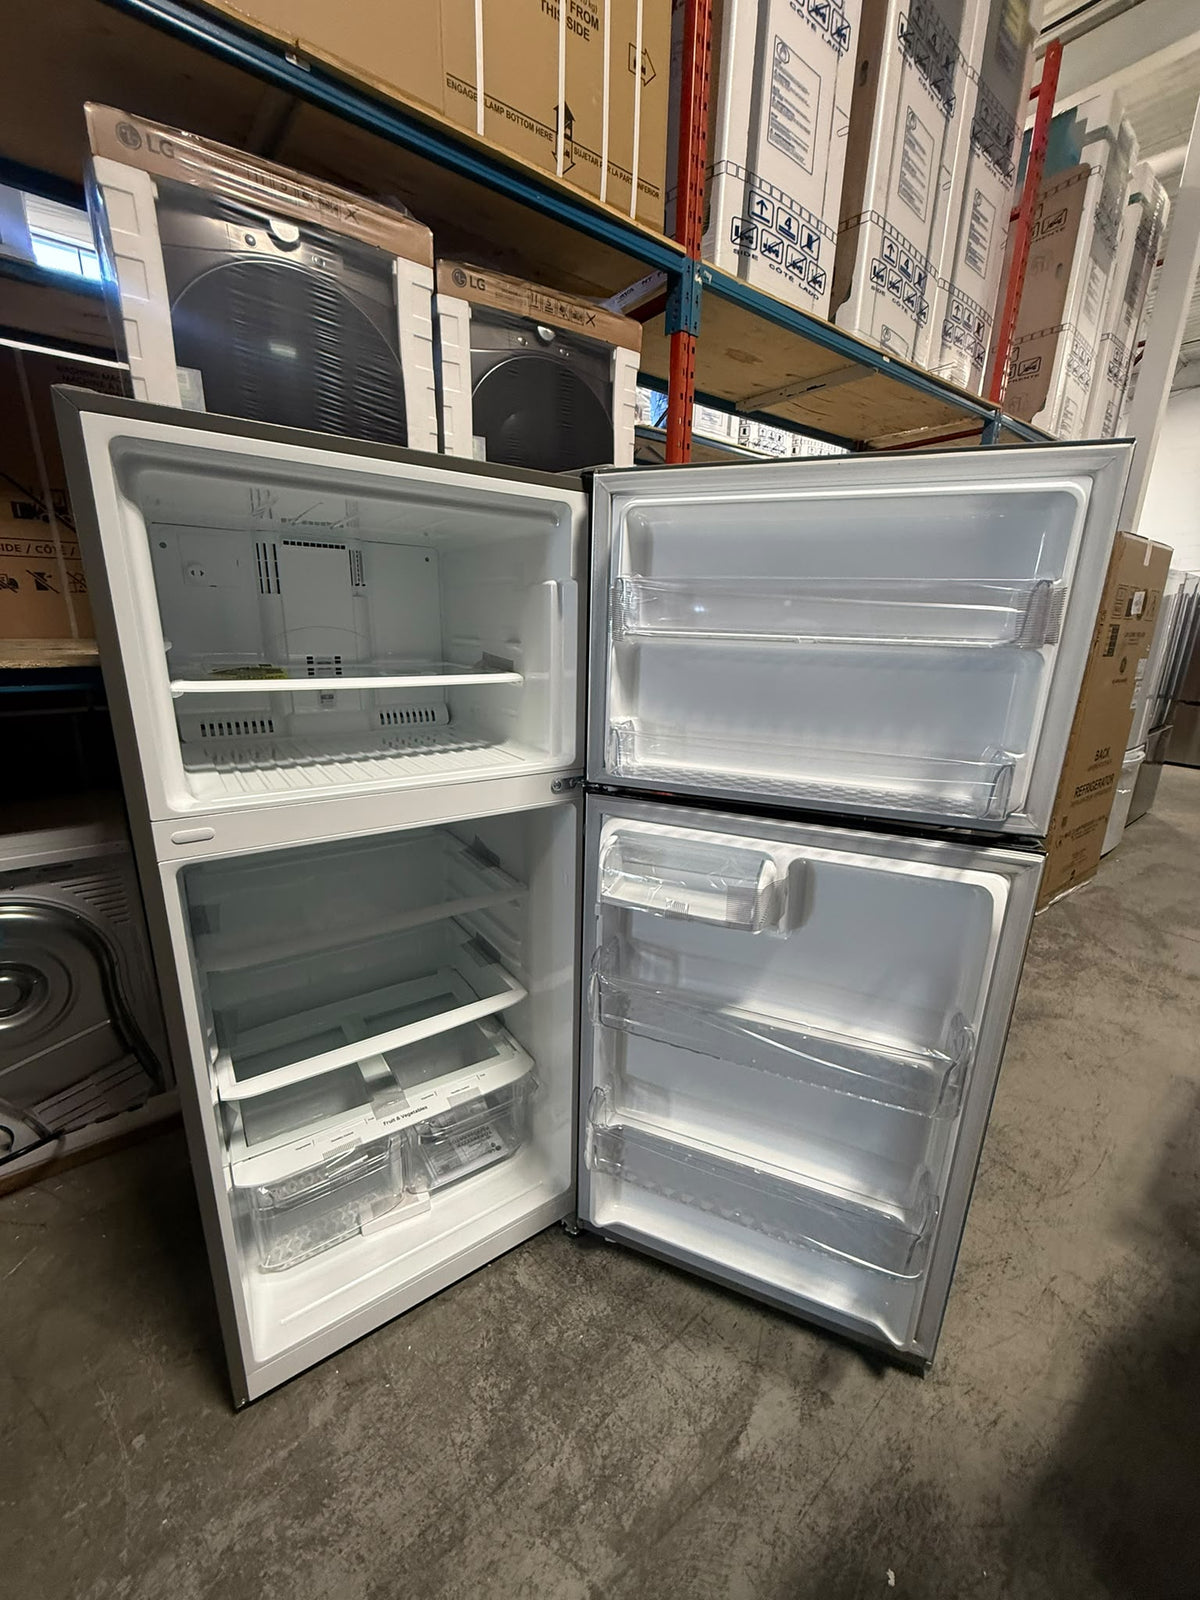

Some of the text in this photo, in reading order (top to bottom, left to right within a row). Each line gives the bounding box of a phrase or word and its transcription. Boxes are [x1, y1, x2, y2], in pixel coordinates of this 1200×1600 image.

[566, 15, 590, 42] SIDE
[570, 0, 599, 31] FROM
[483, 98, 505, 115] LAMP
[505, 109, 535, 132] BOTTOM
[535, 125, 554, 143] HERE
[147, 138, 176, 160] LG
[573, 146, 599, 168] SUJETAR
[611, 168, 619, 179] LA
[469, 275, 486, 292] LG
[733, 247, 759, 261] SIDE
[798, 282, 820, 300] LADO
[0, 543, 23, 554] IDE
[1074, 773, 1115, 799] REFRIGERATOR
[383, 1117, 396, 1126] Fruit
[401, 1105, 428, 1119] Vegetables
